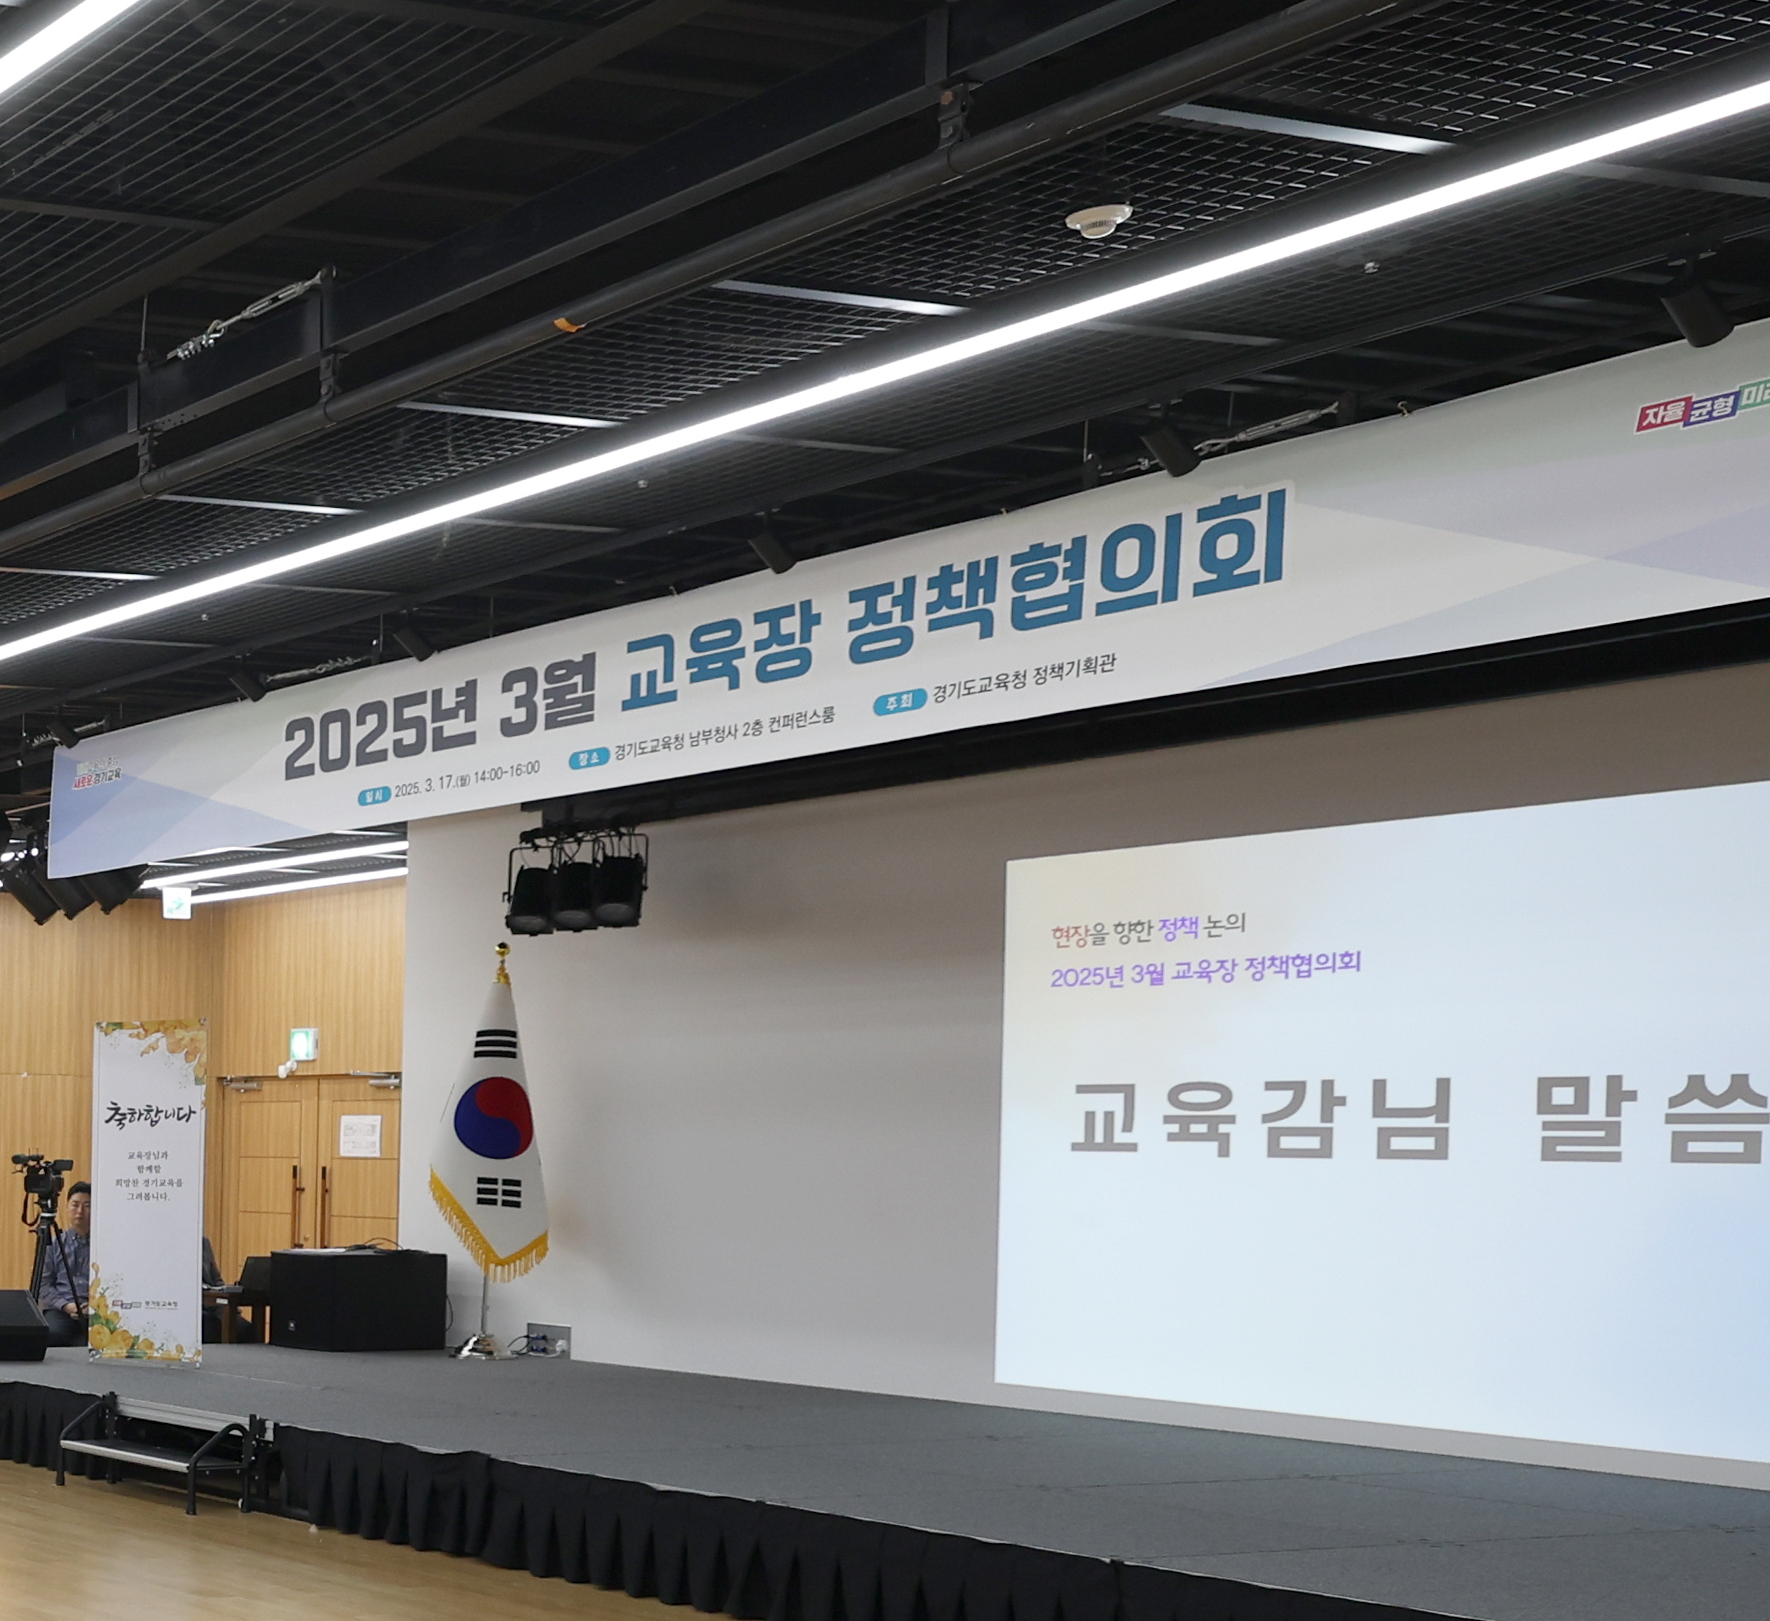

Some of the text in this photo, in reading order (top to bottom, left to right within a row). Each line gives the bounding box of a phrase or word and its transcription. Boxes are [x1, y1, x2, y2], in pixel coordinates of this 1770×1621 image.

[1642, 400, 1686, 427] 자율
[1690, 394, 1735, 422] 균형
[284, 488, 1287, 781] 2025년 3월 교육장 정책협의회
[933, 669, 1028, 703] 경기도교육청
[1033, 653, 1117, 685] 정책기획관
[614, 733, 685, 761] 경기도교육청
[689, 723, 739, 748] 남부청사
[742, 718, 764, 738] 2층
[768, 706, 836, 733] 컨퍼런스룸
[394, 782, 422, 798] 2025.
[425, 778, 435, 792] 3.
[1051, 912, 1246, 949] 현장을 향한 정책 논의
[1051, 950, 1362, 988] 2025년 3월 교육장 정책협의회
[104, 1101, 197, 1131] 축하합니다
[1070, 1073, 1770, 1165] 교육감님 말씀
[127, 1151, 169, 1161] 교육장님과
